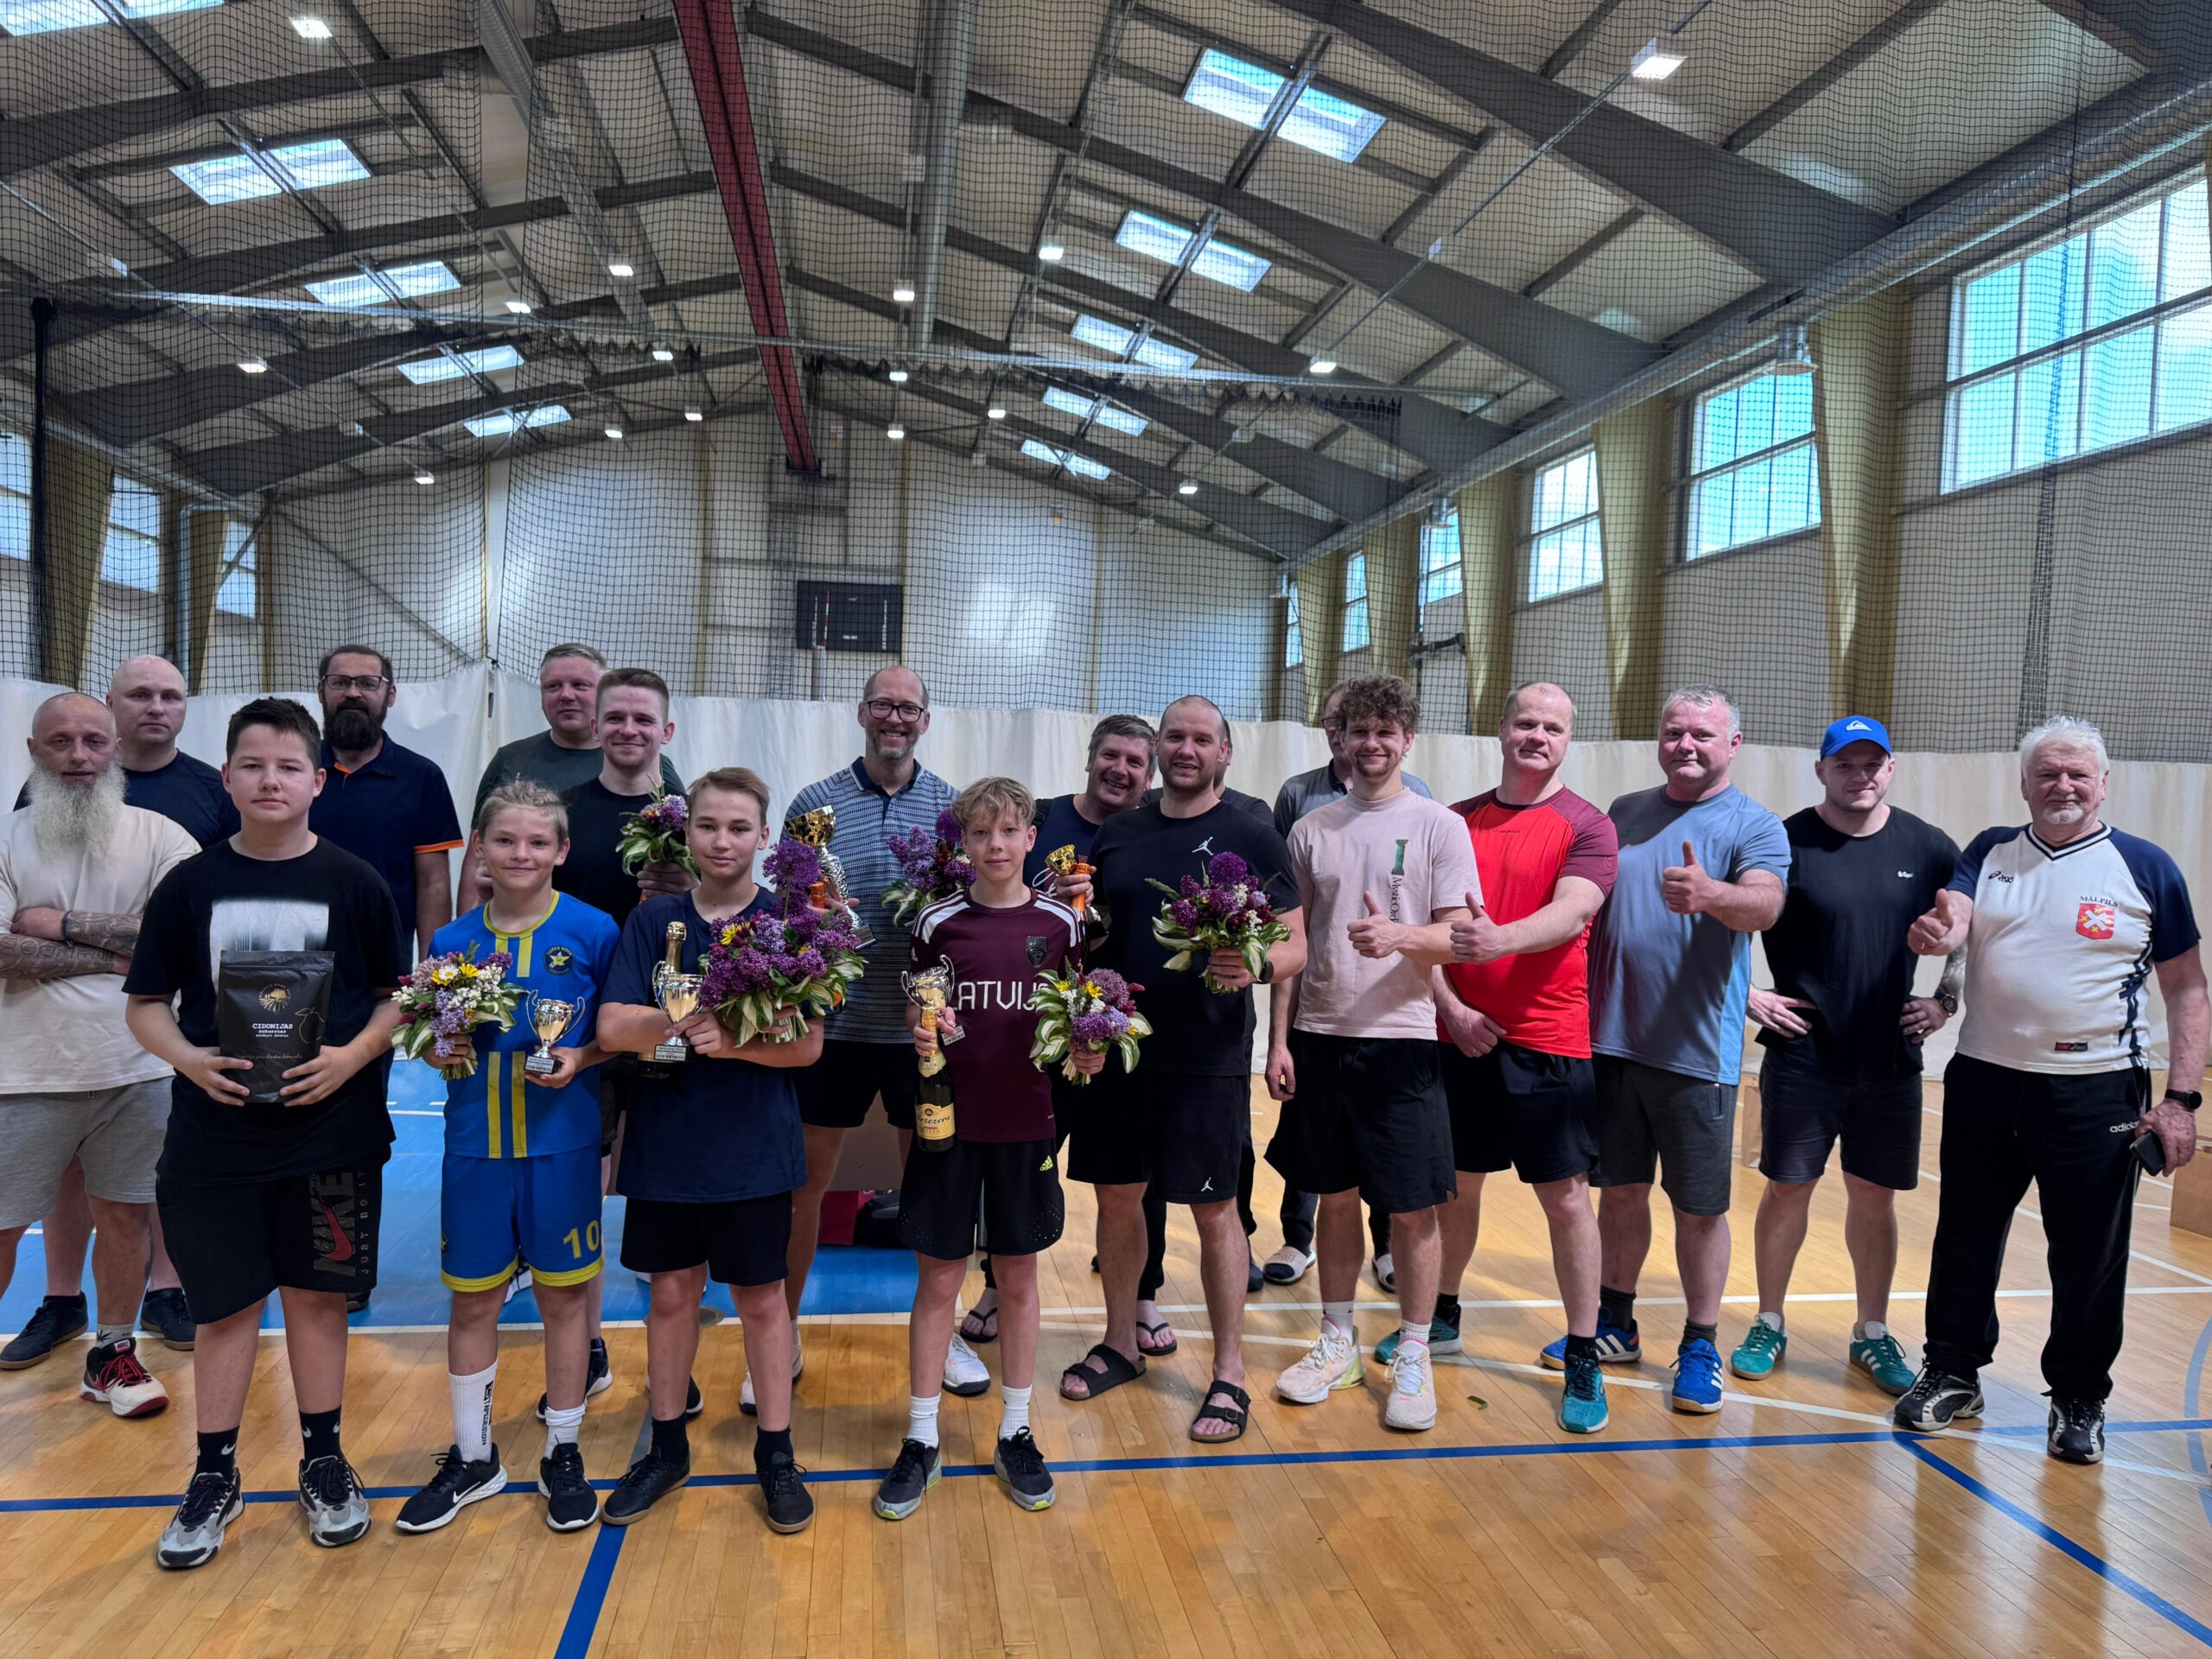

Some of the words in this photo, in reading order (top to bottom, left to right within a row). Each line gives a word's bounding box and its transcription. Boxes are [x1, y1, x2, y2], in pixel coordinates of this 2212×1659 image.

[954, 981, 1049, 1012] ATVIJ
[359, 1199, 369, 1218] DO
[359, 1232, 369, 1274] JUST
[563, 1219, 600, 1259] 10
